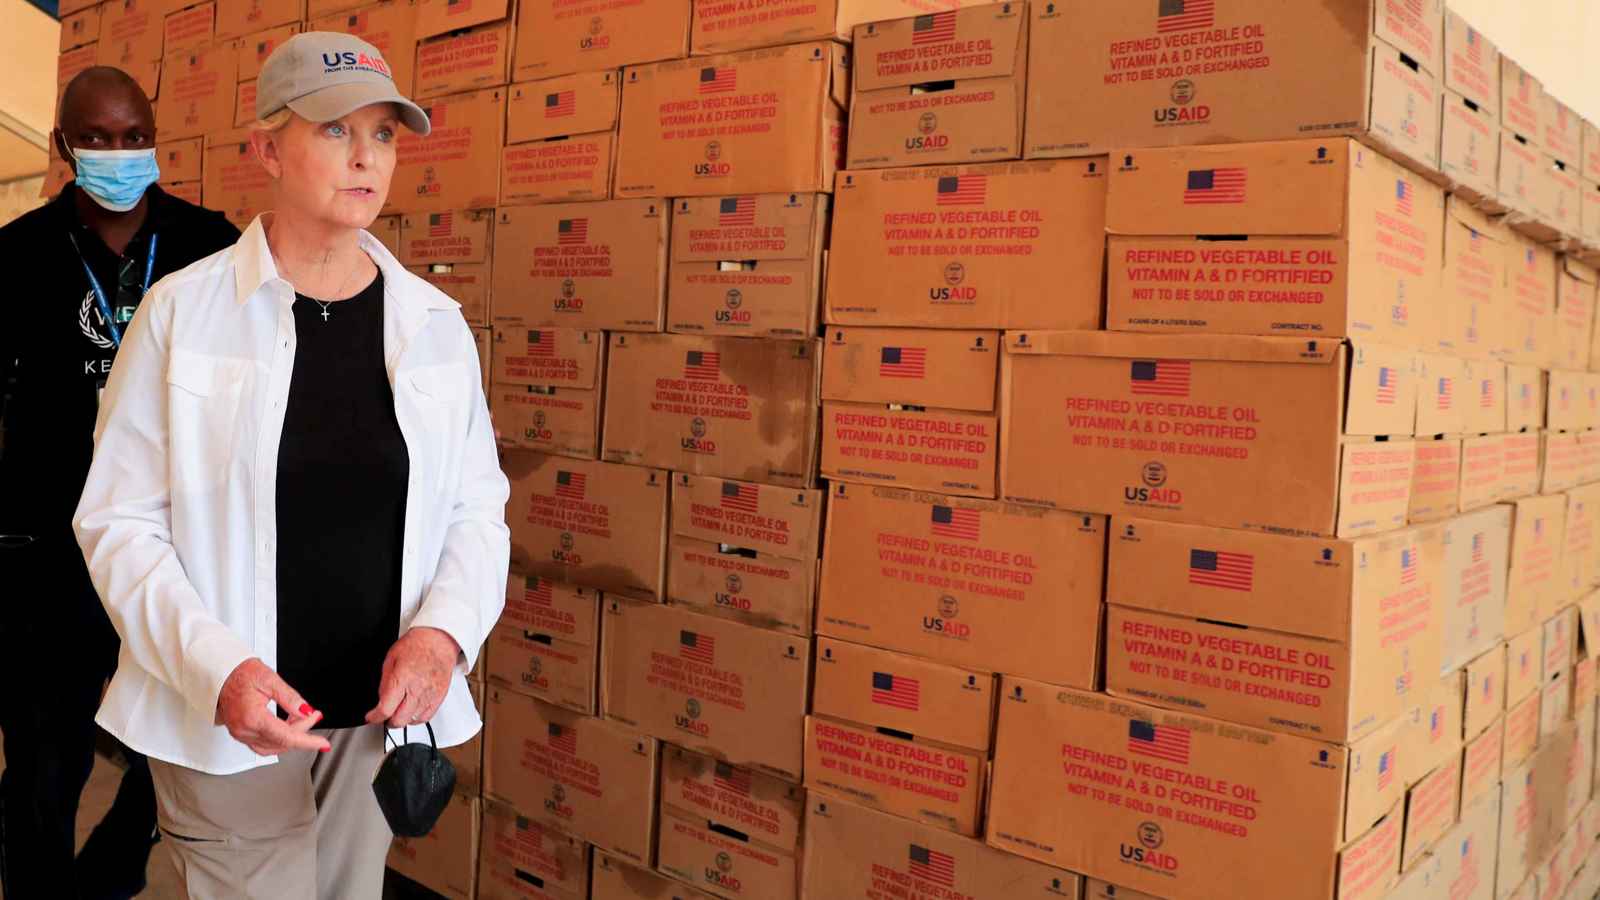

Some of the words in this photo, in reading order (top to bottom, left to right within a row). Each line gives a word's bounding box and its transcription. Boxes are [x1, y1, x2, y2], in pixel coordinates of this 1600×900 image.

[1109, 36, 1161, 54] REFINED
[1164, 27, 1239, 48] VEGETABLE
[1242, 24, 1265, 39] OIL
[876, 47, 915, 64] REFINED
[917, 40, 974, 60] VEGETABLE
[976, 38, 993, 53] OIL
[1110, 52, 1156, 69] VITAMIN
[1159, 51, 1168, 65] A
[1171, 50, 1179, 63] &
[1183, 48, 1192, 62] D
[1195, 41, 1263, 61] FORTIFIED
[322, 51, 391, 76] USAID
[876, 60, 912, 76] VITAMIN
[913, 59, 920, 73] A
[921, 59, 928, 72] &
[931, 58, 938, 71] D
[939, 53, 992, 71] FORTIFIED
[1103, 71, 1122, 84] NOT
[1126, 69, 1138, 82] TO
[1140, 68, 1154, 81] BE
[1155, 65, 1183, 79] SOLD
[1185, 64, 1202, 77] OR
[1202, 57, 1269, 75] EXCHANGED
[659, 100, 699, 115] REFINED
[701, 94, 759, 111] VEGETABLE
[761, 92, 778, 106] OIL
[1154, 106, 1209, 123] USAID
[905, 135, 948, 150] USAID
[694, 163, 730, 176] USAID
[884, 212, 936, 225] REFINED
[939, 211, 1016, 224] VEGETABLE
[1019, 210, 1043, 223] OIL
[688, 230, 721, 241] REFINED
[722, 229, 769, 240] VEGETABLE
[772, 229, 786, 239] OIL
[884, 227, 932, 240] VITAMIN
[933, 227, 943, 240] A
[945, 227, 955, 239] &
[956, 227, 968, 239] D
[968, 226, 1039, 239] FORTIFIED
[1125, 250, 1196, 264] REFINED
[1200, 250, 1300, 265] VEGETABLE
[1306, 251, 1337, 265] OIL
[1127, 268, 1190, 283] VITAMIN
[1194, 269, 1204, 283] A
[1209, 269, 1220, 283] &
[1224, 269, 1237, 283] D
[1241, 269, 1333, 284] FORTIFIED
[554, 300, 582, 309] USAID
[930, 287, 976, 301] USAID
[1132, 289, 1153, 301] NOT
[1158, 290, 1172, 301] TO
[1175, 290, 1190, 302] BE
[1193, 290, 1225, 302] SOLD
[1227, 291, 1244, 302] OR
[1247, 291, 1324, 304] EXCHANGED
[715, 311, 751, 322] USAID
[1066, 399, 1131, 415] REFINED
[1135, 402, 1227, 421] VEGETABLE
[1232, 408, 1260, 422] OIL
[525, 428, 552, 440] USAID
[835, 413, 887, 429] REFINED
[889, 417, 963, 435] VEGETABLE
[966, 423, 988, 437] OIL
[1068, 416, 1126, 432] VITAMIN
[1129, 420, 1140, 433] A
[1144, 421, 1153, 433] &
[1157, 421, 1171, 435] D
[1173, 422, 1256, 440] FORTIFIED
[681, 438, 715, 452] USAID
[836, 430, 883, 445] VITAMIN
[885, 433, 893, 446] A
[896, 434, 905, 447] &
[907, 435, 918, 448] D
[918, 436, 986, 453] FORTIFIED
[1072, 436, 1092, 447] NOT
[1095, 437, 1110, 449] TO
[1111, 438, 1127, 450] BE
[1127, 440, 1158, 452] SOLD
[1159, 442, 1176, 453] OR
[1178, 443, 1248, 459] EXCHANGED
[1124, 487, 1181, 504] USAID
[552, 550, 582, 565] USAID
[877, 534, 929, 553] REFINED
[934, 542, 1009, 565] VEGETABLE
[1013, 553, 1036, 569] OIL
[878, 551, 924, 567] VITAMIN
[928, 558, 936, 568] A
[940, 559, 948, 571] &
[952, 561, 960, 572] D
[964, 563, 1032, 585] FORTIFIED
[715, 593, 751, 610] USAID
[923, 616, 969, 637] USAID
[1121, 621, 1192, 646] REFINED
[1197, 633, 1298, 664] VEGETABLE
[1303, 651, 1335, 670] OIL
[1124, 640, 1186, 663] VITAMIN
[1190, 651, 1201, 666] A
[1205, 653, 1216, 669] &
[1221, 656, 1234, 672] D
[1238, 659, 1330, 688] FORTIFIED
[522, 672, 548, 689] USAID
[1128, 661, 1150, 676] NOT
[1156, 666, 1169, 679] TO
[1172, 669, 1187, 682] BE
[1190, 672, 1221, 689] SOLD
[1224, 678, 1241, 692] OR
[1244, 681, 1321, 707] EXCHANGED
[675, 716, 708, 735] USAID
[815, 724, 866, 748] REFINED
[868, 736, 943, 766] VEGETABLE
[946, 754, 968, 772] OIL
[816, 741, 862, 763] VITAMIN
[863, 751, 873, 766] A
[873, 754, 884, 768] &
[885, 756, 896, 771] D
[898, 759, 966, 788] FORTIFIED
[1061, 745, 1127, 772] REFINED
[1132, 760, 1227, 795] VEGETABLE
[1231, 781, 1260, 802] OIL
[1063, 763, 1122, 789] VITAMIN
[1125, 777, 1136, 792] A
[1139, 780, 1149, 795] &
[1154, 783, 1166, 799] D
[1169, 787, 1256, 820] FORTIFIED
[1120, 844, 1177, 871] USAID
[705, 868, 741, 891] USAID
